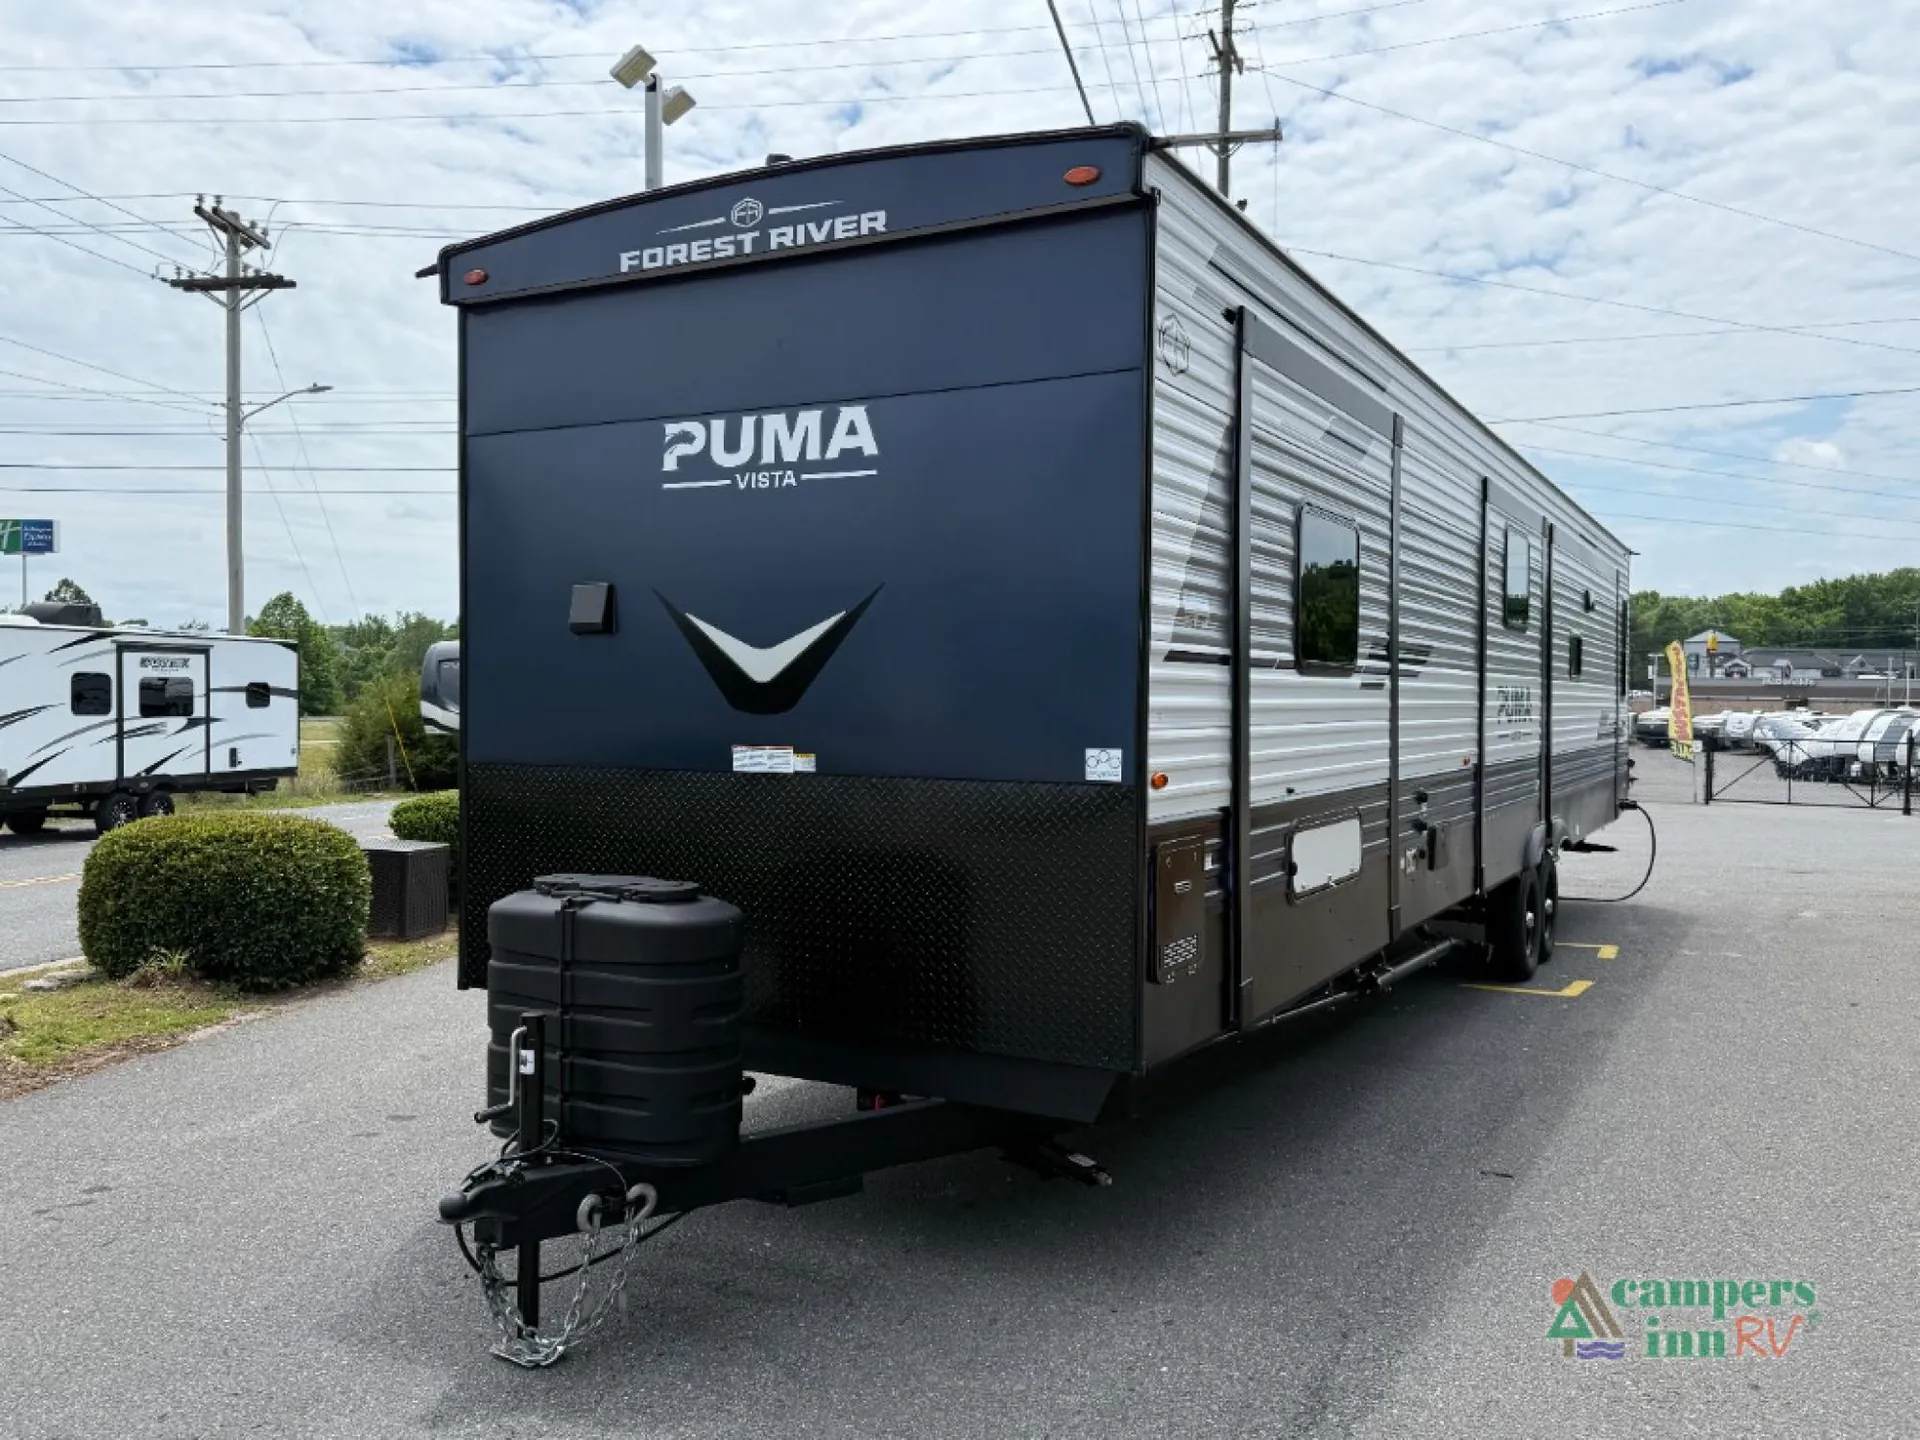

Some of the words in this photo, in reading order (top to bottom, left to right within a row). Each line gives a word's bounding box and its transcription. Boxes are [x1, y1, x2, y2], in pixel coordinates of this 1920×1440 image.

[619, 230, 760, 273] FOREST
[768, 210, 887, 250] RIVER
[661, 405, 879, 472] PUMA
[735, 470, 798, 490] VISTA
